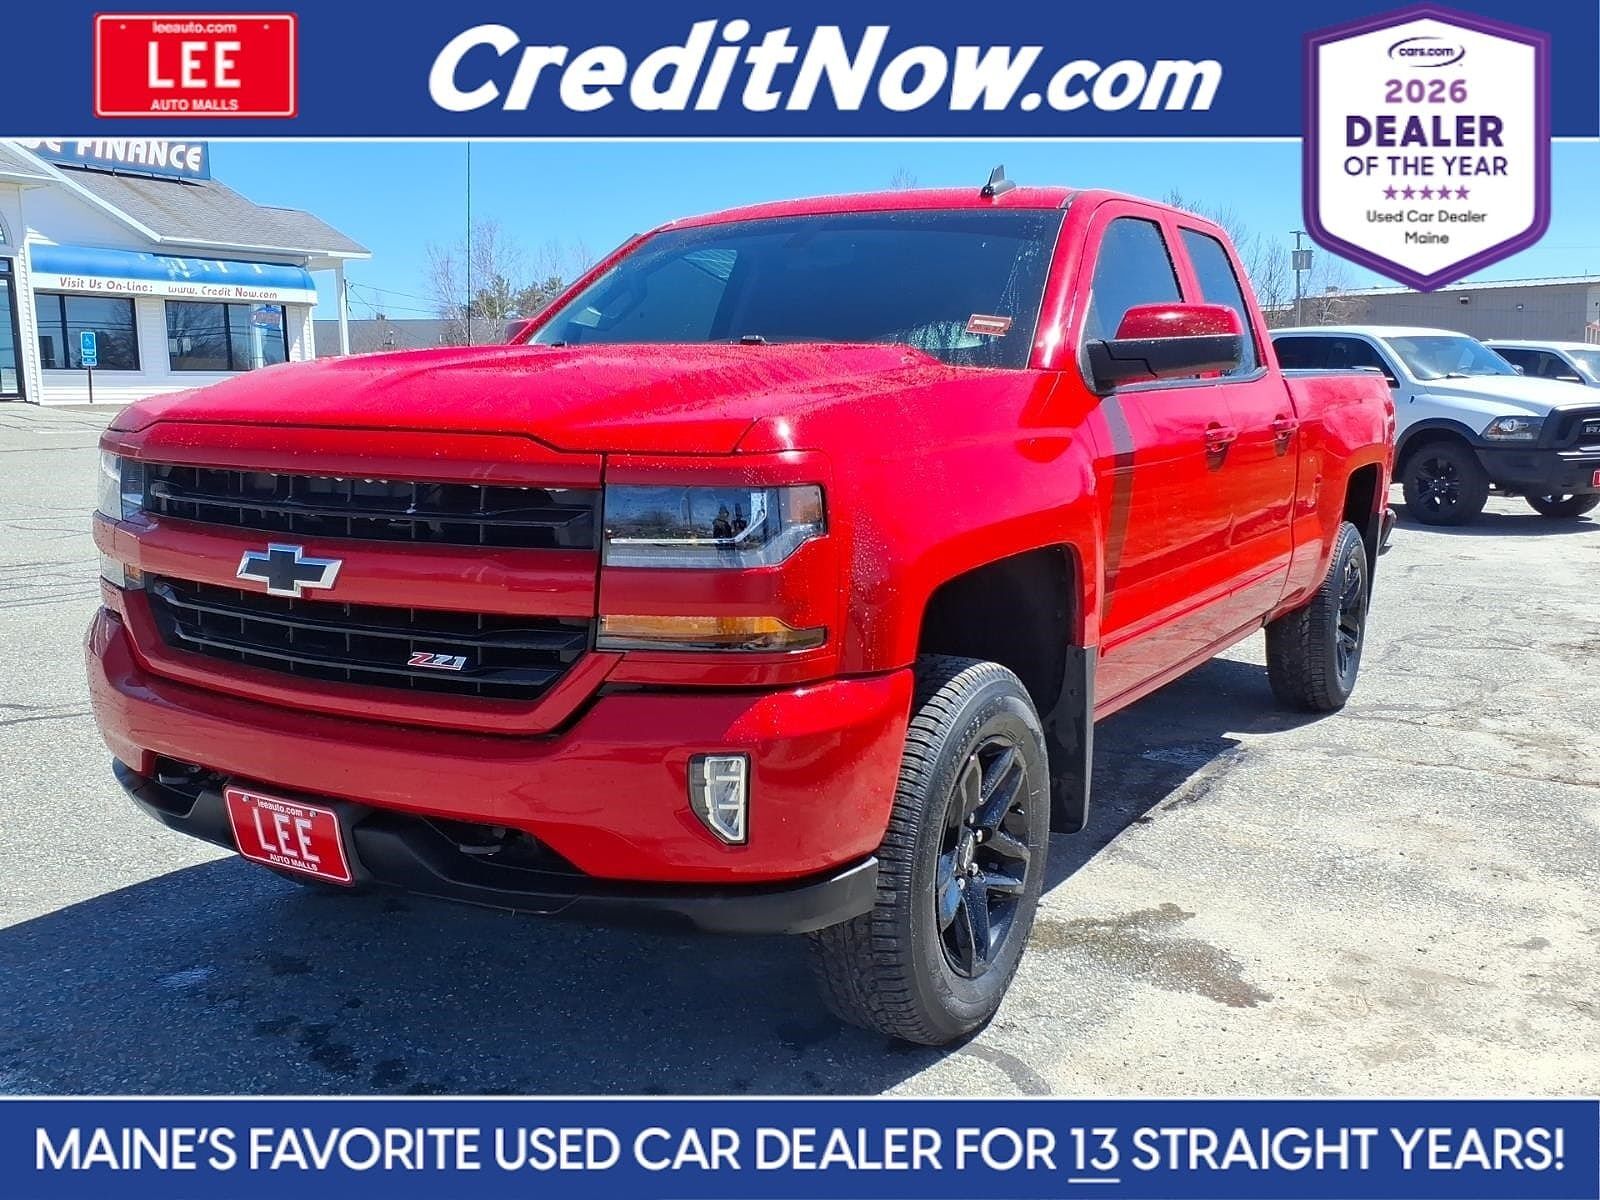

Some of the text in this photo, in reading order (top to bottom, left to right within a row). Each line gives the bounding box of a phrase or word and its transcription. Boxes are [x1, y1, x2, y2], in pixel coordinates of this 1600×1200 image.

[76, 141, 202, 172] FINANCE
[59, 276, 85, 289] Visit
[89, 279, 102, 289] Us
[201, 286, 231, 297] Credit
[407, 651, 467, 671] Z71
[257, 799, 303, 817] leeauto.com
[252, 806, 320, 863] LEE
[269, 853, 318, 872] AUTO MALLS
